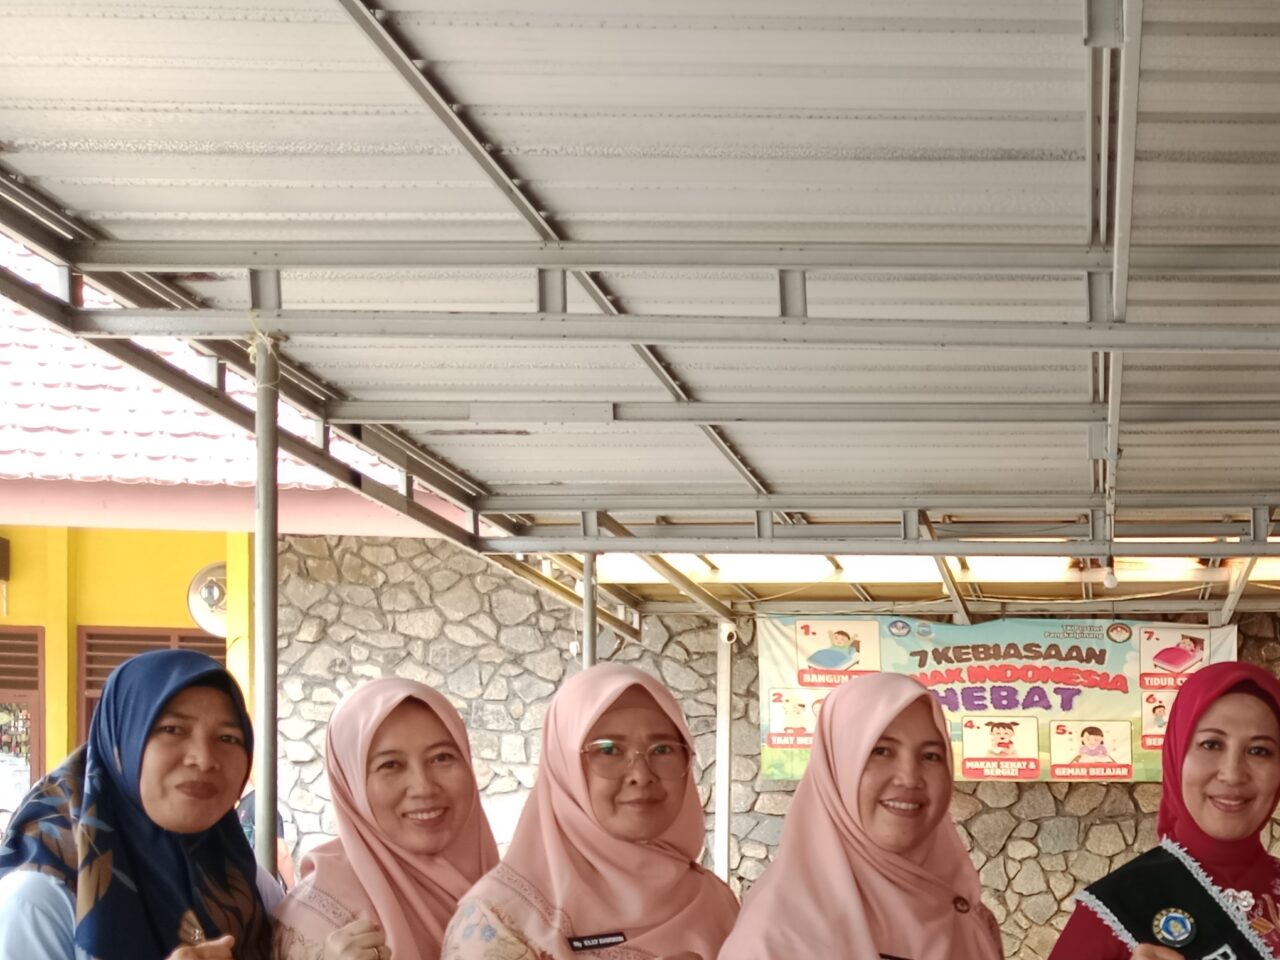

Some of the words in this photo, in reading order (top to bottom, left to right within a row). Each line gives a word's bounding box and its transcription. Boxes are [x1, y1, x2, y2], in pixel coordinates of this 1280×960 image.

[801, 624, 817, 636] 1.
[1144, 630, 1160, 641] 7.
[910, 650, 928, 668] 7
[931, 643, 1106, 665] KEBIASAAN
[967, 664, 1128, 693] INDONESIA
[1144, 677, 1174, 686] TIDUR
[930, 686, 1082, 711] HEBAT
[1146, 694, 1162, 704] 6.
[964, 720, 980, 730] 4.
[1056, 725, 1073, 735] 5.
[966, 761, 998, 769] MAKAN
[1055, 767, 1087, 776] GEMAR
[1089, 768, 1128, 776] BELAJAR
